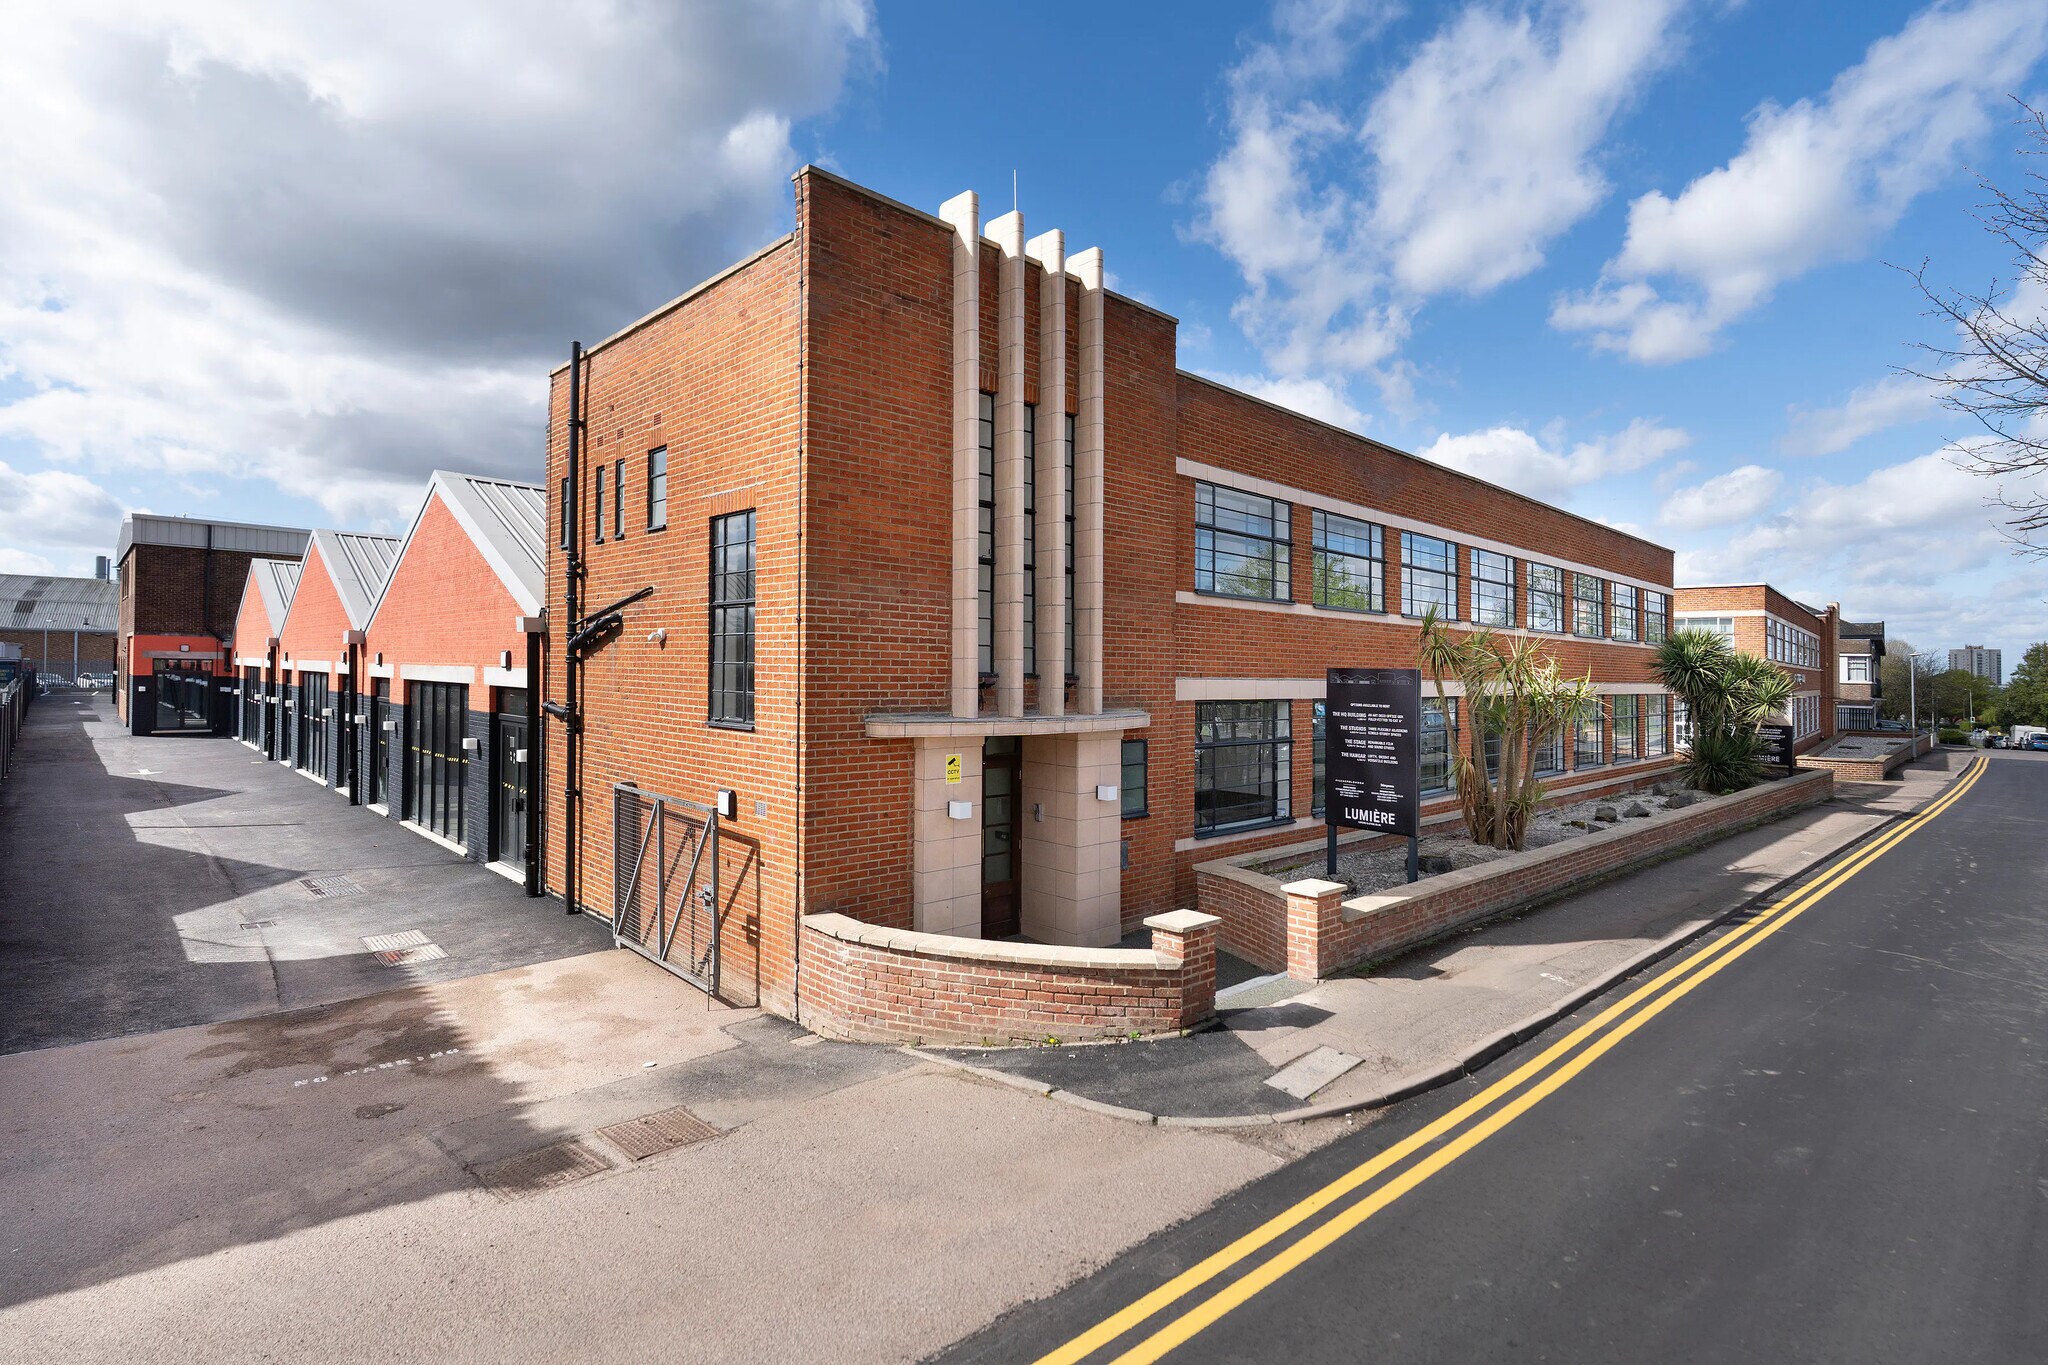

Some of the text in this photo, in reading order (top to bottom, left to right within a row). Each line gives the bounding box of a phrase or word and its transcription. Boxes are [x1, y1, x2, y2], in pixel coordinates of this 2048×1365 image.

[1345, 807, 1395, 825] LUMIÈRE
[294, 1048, 459, 1087] NO PARKING
